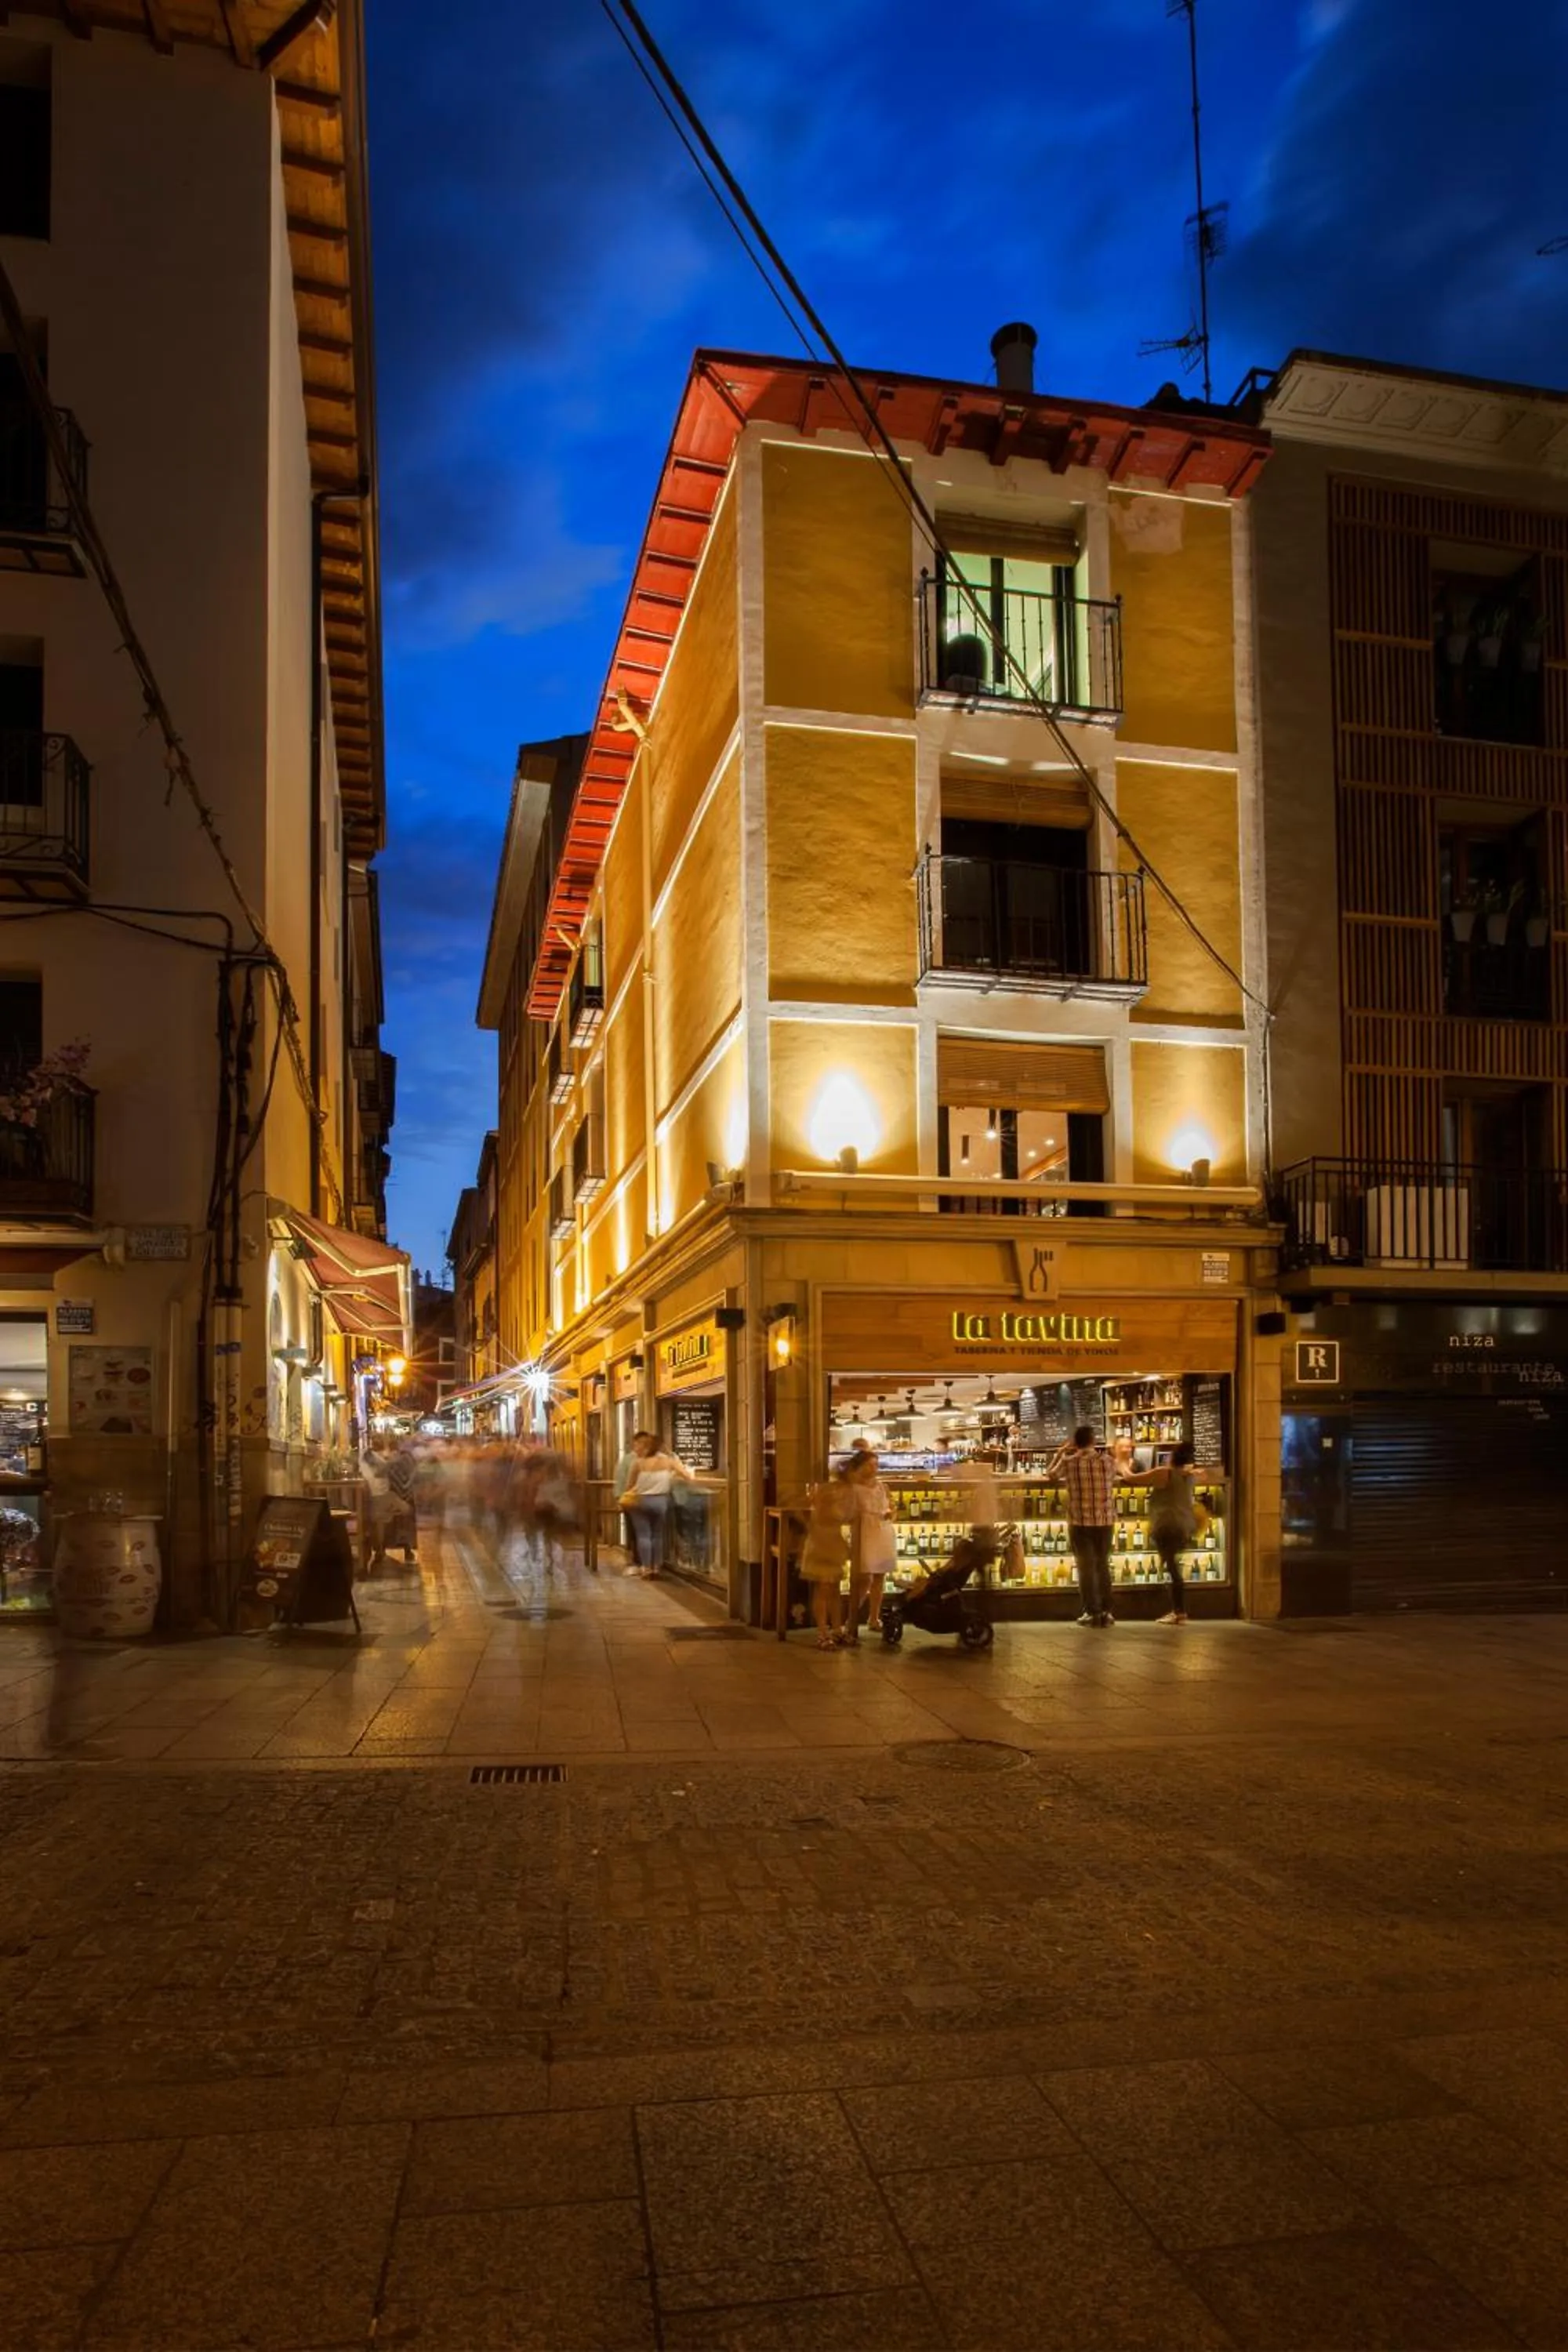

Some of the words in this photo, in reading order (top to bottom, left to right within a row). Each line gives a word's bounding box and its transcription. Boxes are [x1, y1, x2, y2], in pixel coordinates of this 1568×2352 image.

[952, 1310, 991, 1341] la
[1001, 1310, 1121, 1341] tavina
[1448, 1332, 1495, 1348] niza
[1021, 1346, 1063, 1356] TIENDA
[1432, 1360, 1555, 1375] restaurante
